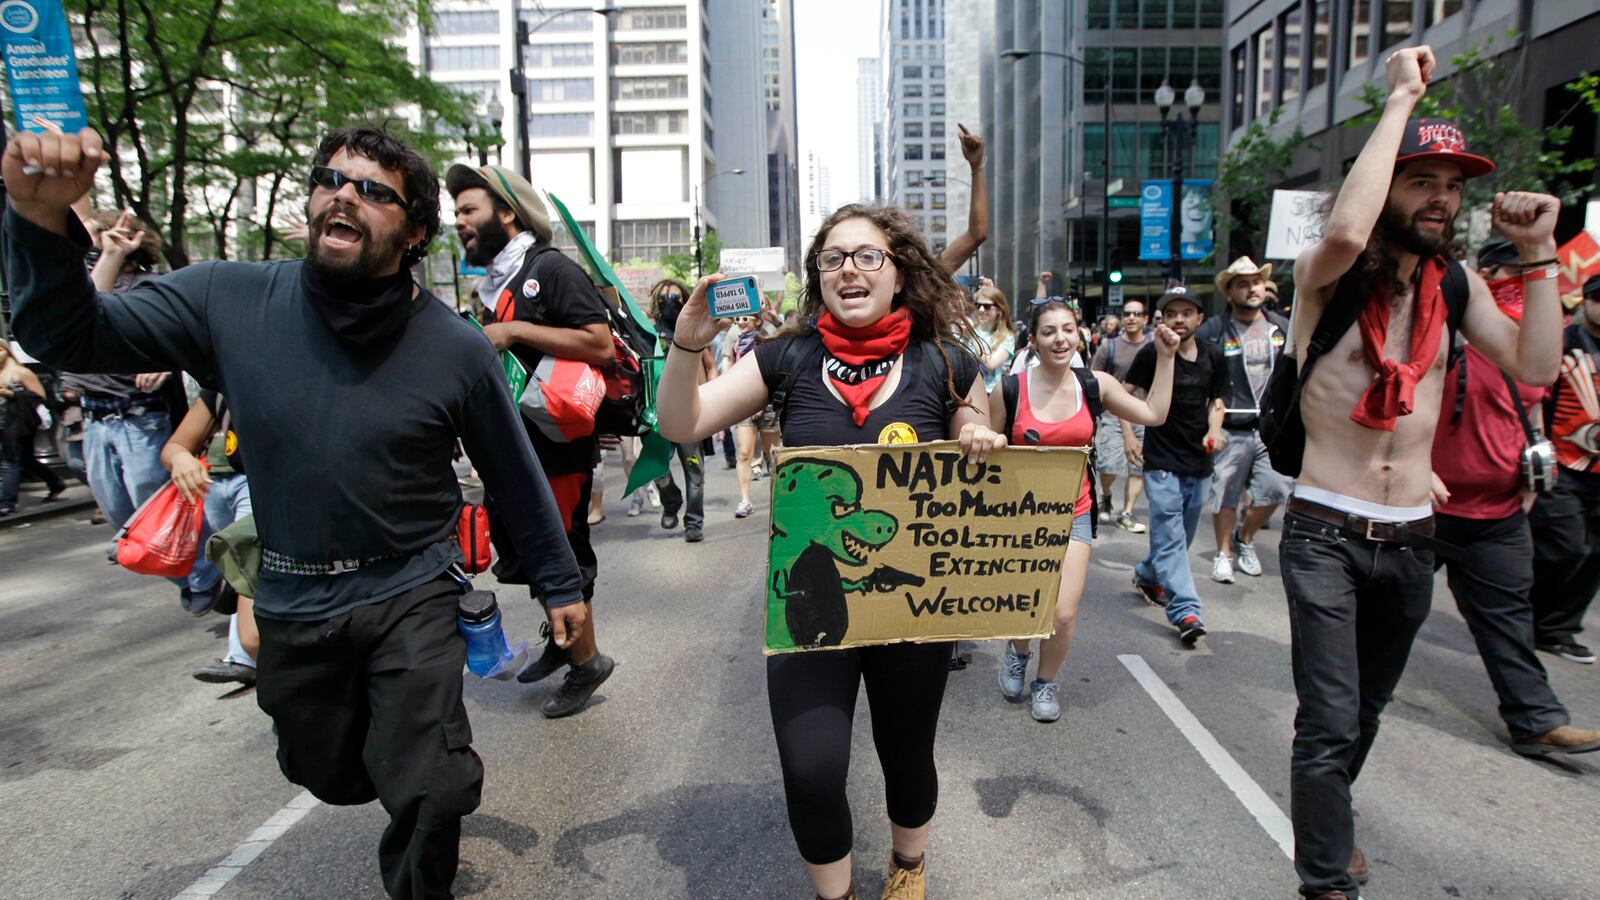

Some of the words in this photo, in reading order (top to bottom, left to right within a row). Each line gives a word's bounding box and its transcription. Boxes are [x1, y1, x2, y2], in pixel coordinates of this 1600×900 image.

[6, 42, 47, 54] Annual
[12, 67, 69, 80] Luncheon
[716, 289, 737, 298] TAPPED
[738, 288, 744, 296] IS
[716, 304, 734, 312] PHONE
[735, 302, 749, 310] THIS
[876, 451, 1002, 493] NATO:
[1019, 490, 1073, 516] ARMOR
[960, 525, 1034, 549] LITTLE
[929, 552, 1061, 577] EXTINCTION
[904, 586, 1040, 618] WELCOME!
